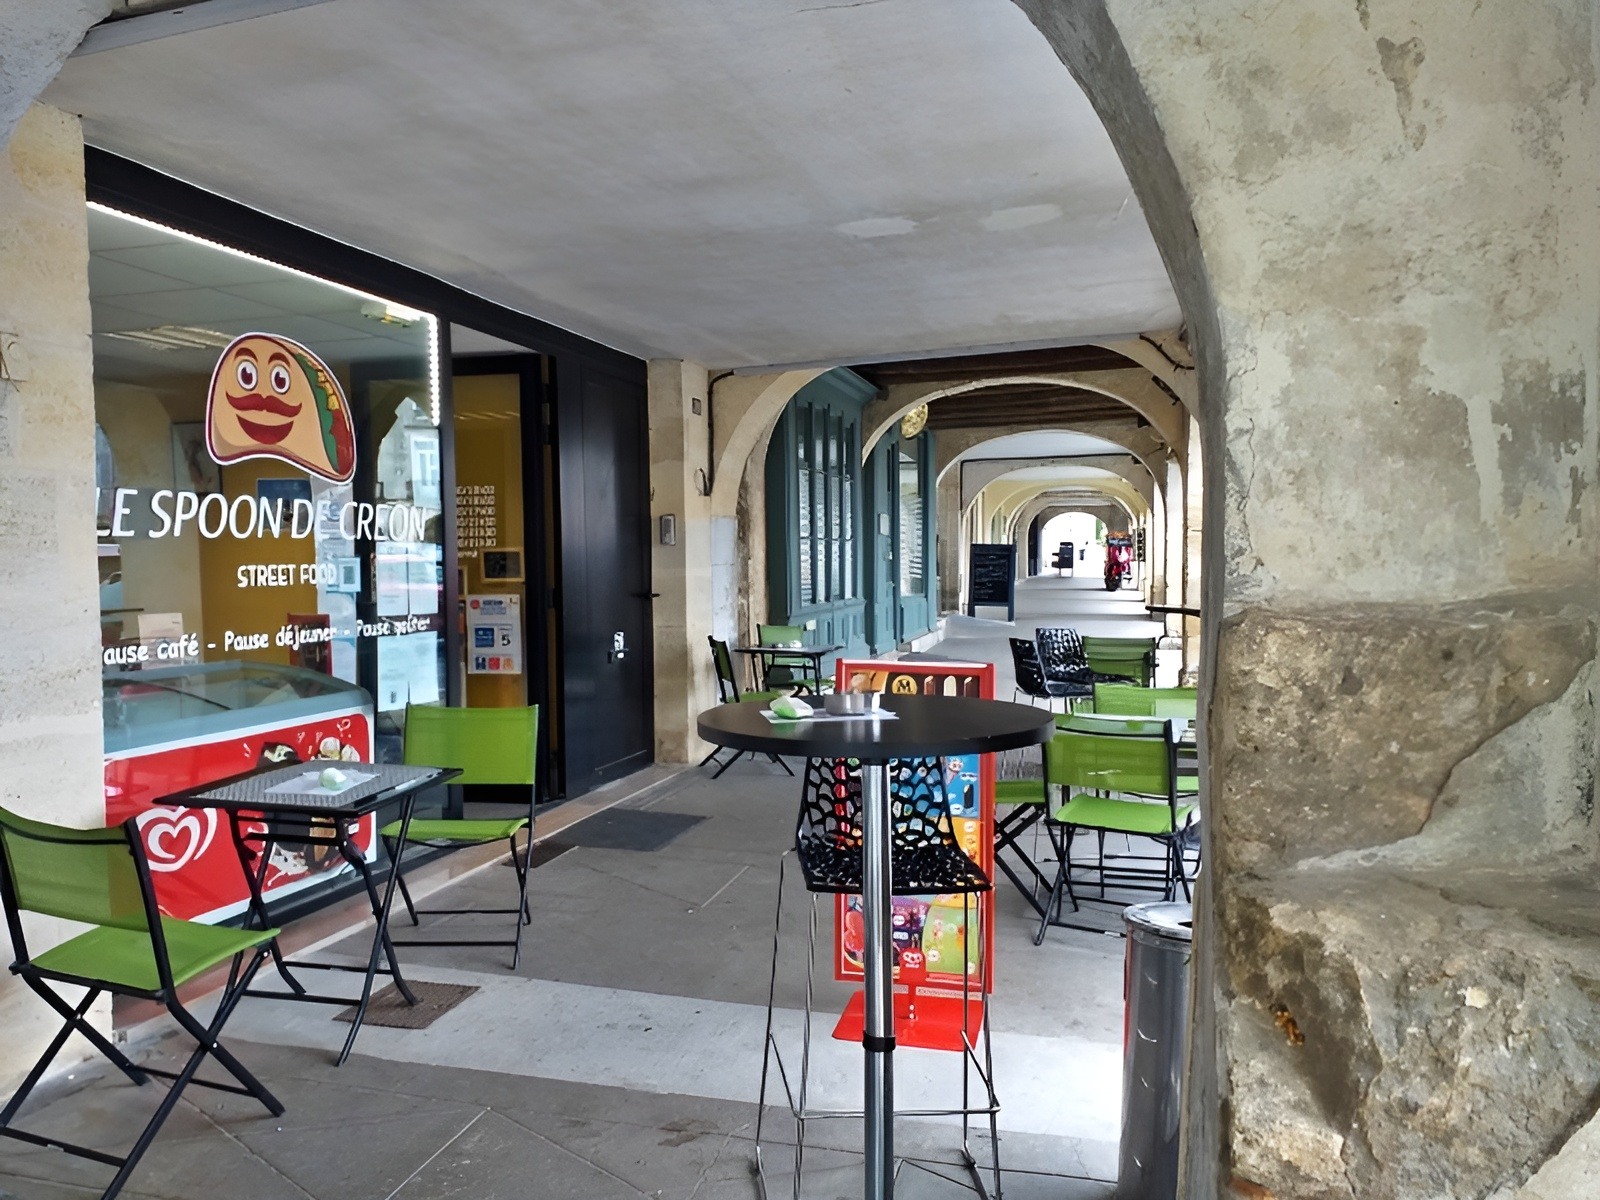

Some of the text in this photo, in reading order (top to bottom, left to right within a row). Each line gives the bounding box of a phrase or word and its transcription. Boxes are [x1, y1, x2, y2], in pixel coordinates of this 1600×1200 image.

[96, 487, 138, 537] LE
[148, 489, 283, 540] SPOON
[291, 498, 331, 540] DE
[339, 501, 427, 541] CREON
[237, 563, 338, 588] STREET FOOD
[101, 644, 150, 665] ause
[156, 633, 200, 661] café
[224, 630, 269, 652] Pause
[275, 624, 337, 651] déjeuner
